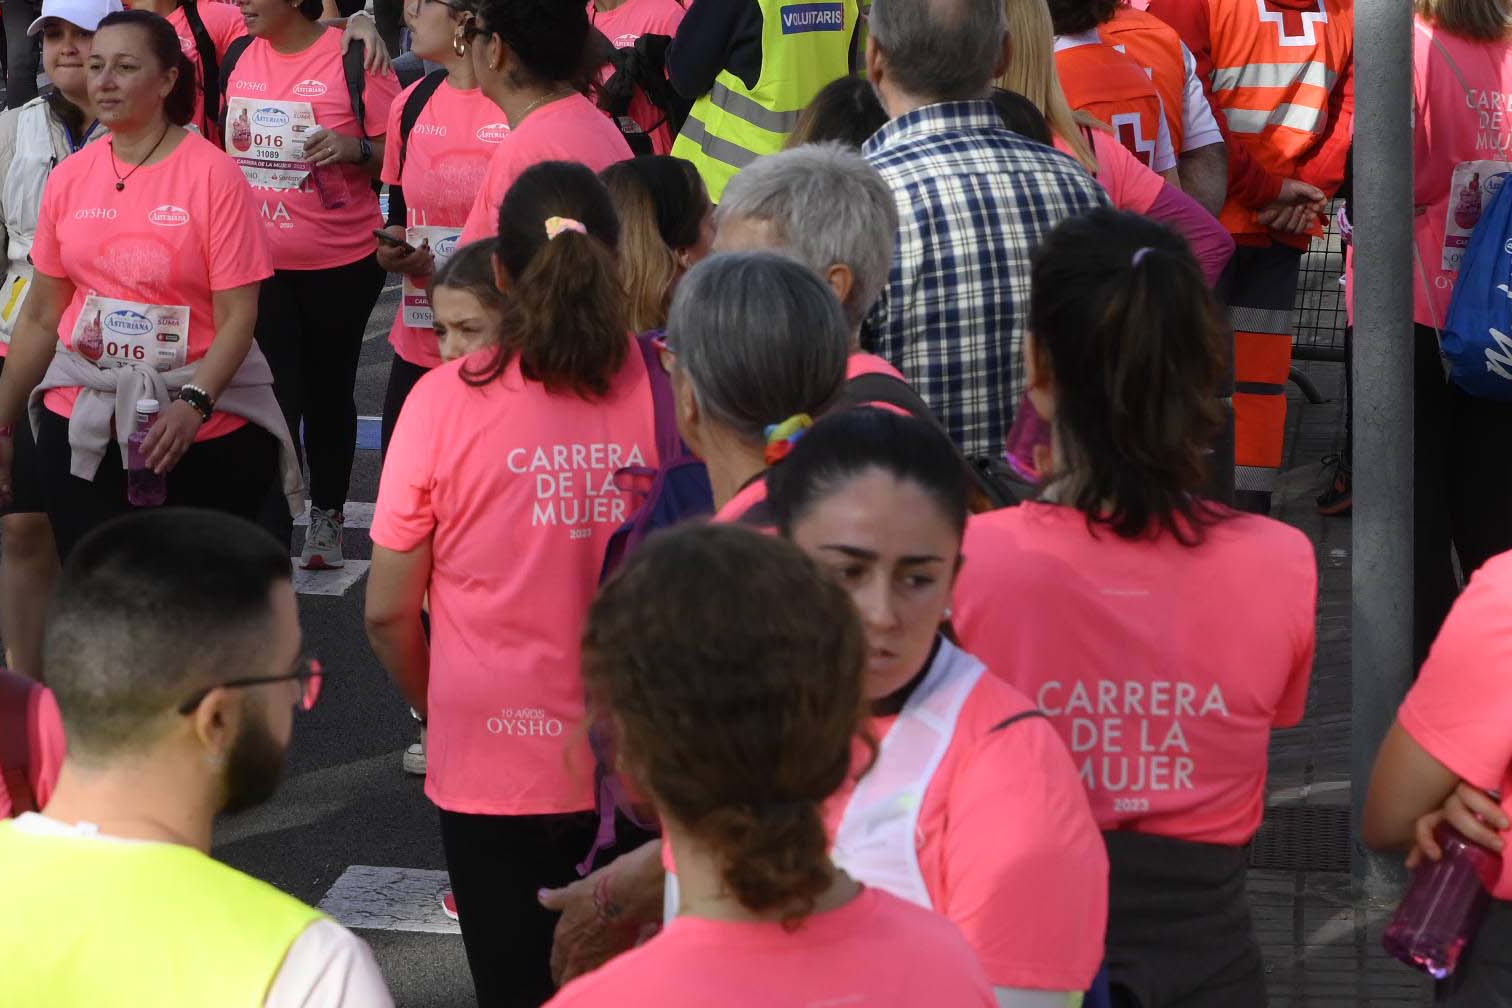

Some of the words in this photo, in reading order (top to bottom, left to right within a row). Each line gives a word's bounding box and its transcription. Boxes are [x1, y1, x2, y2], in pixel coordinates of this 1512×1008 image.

[236, 80, 266, 91] OYSHO
[412, 124, 447, 136] OYSHO
[254, 133, 283, 147] 016
[256, 149, 279, 159] 31089
[75, 208, 118, 220] OYSHO
[109, 319, 149, 331] ASTURIANA
[106, 342, 145, 359] 016
[506, 442, 647, 474] CARRERA
[536, 474, 574, 499] DE
[585, 471, 621, 496] LA
[531, 498, 627, 527] MUJER
[1037, 680, 1229, 716] CARRERA
[501, 708, 513, 719] 10
[514, 706, 546, 720] AÑOS
[487, 716, 563, 737] OYSHO
[1071, 719, 1124, 752] DE
[1139, 719, 1190, 752] LA
[1113, 797, 1150, 812] 2023
